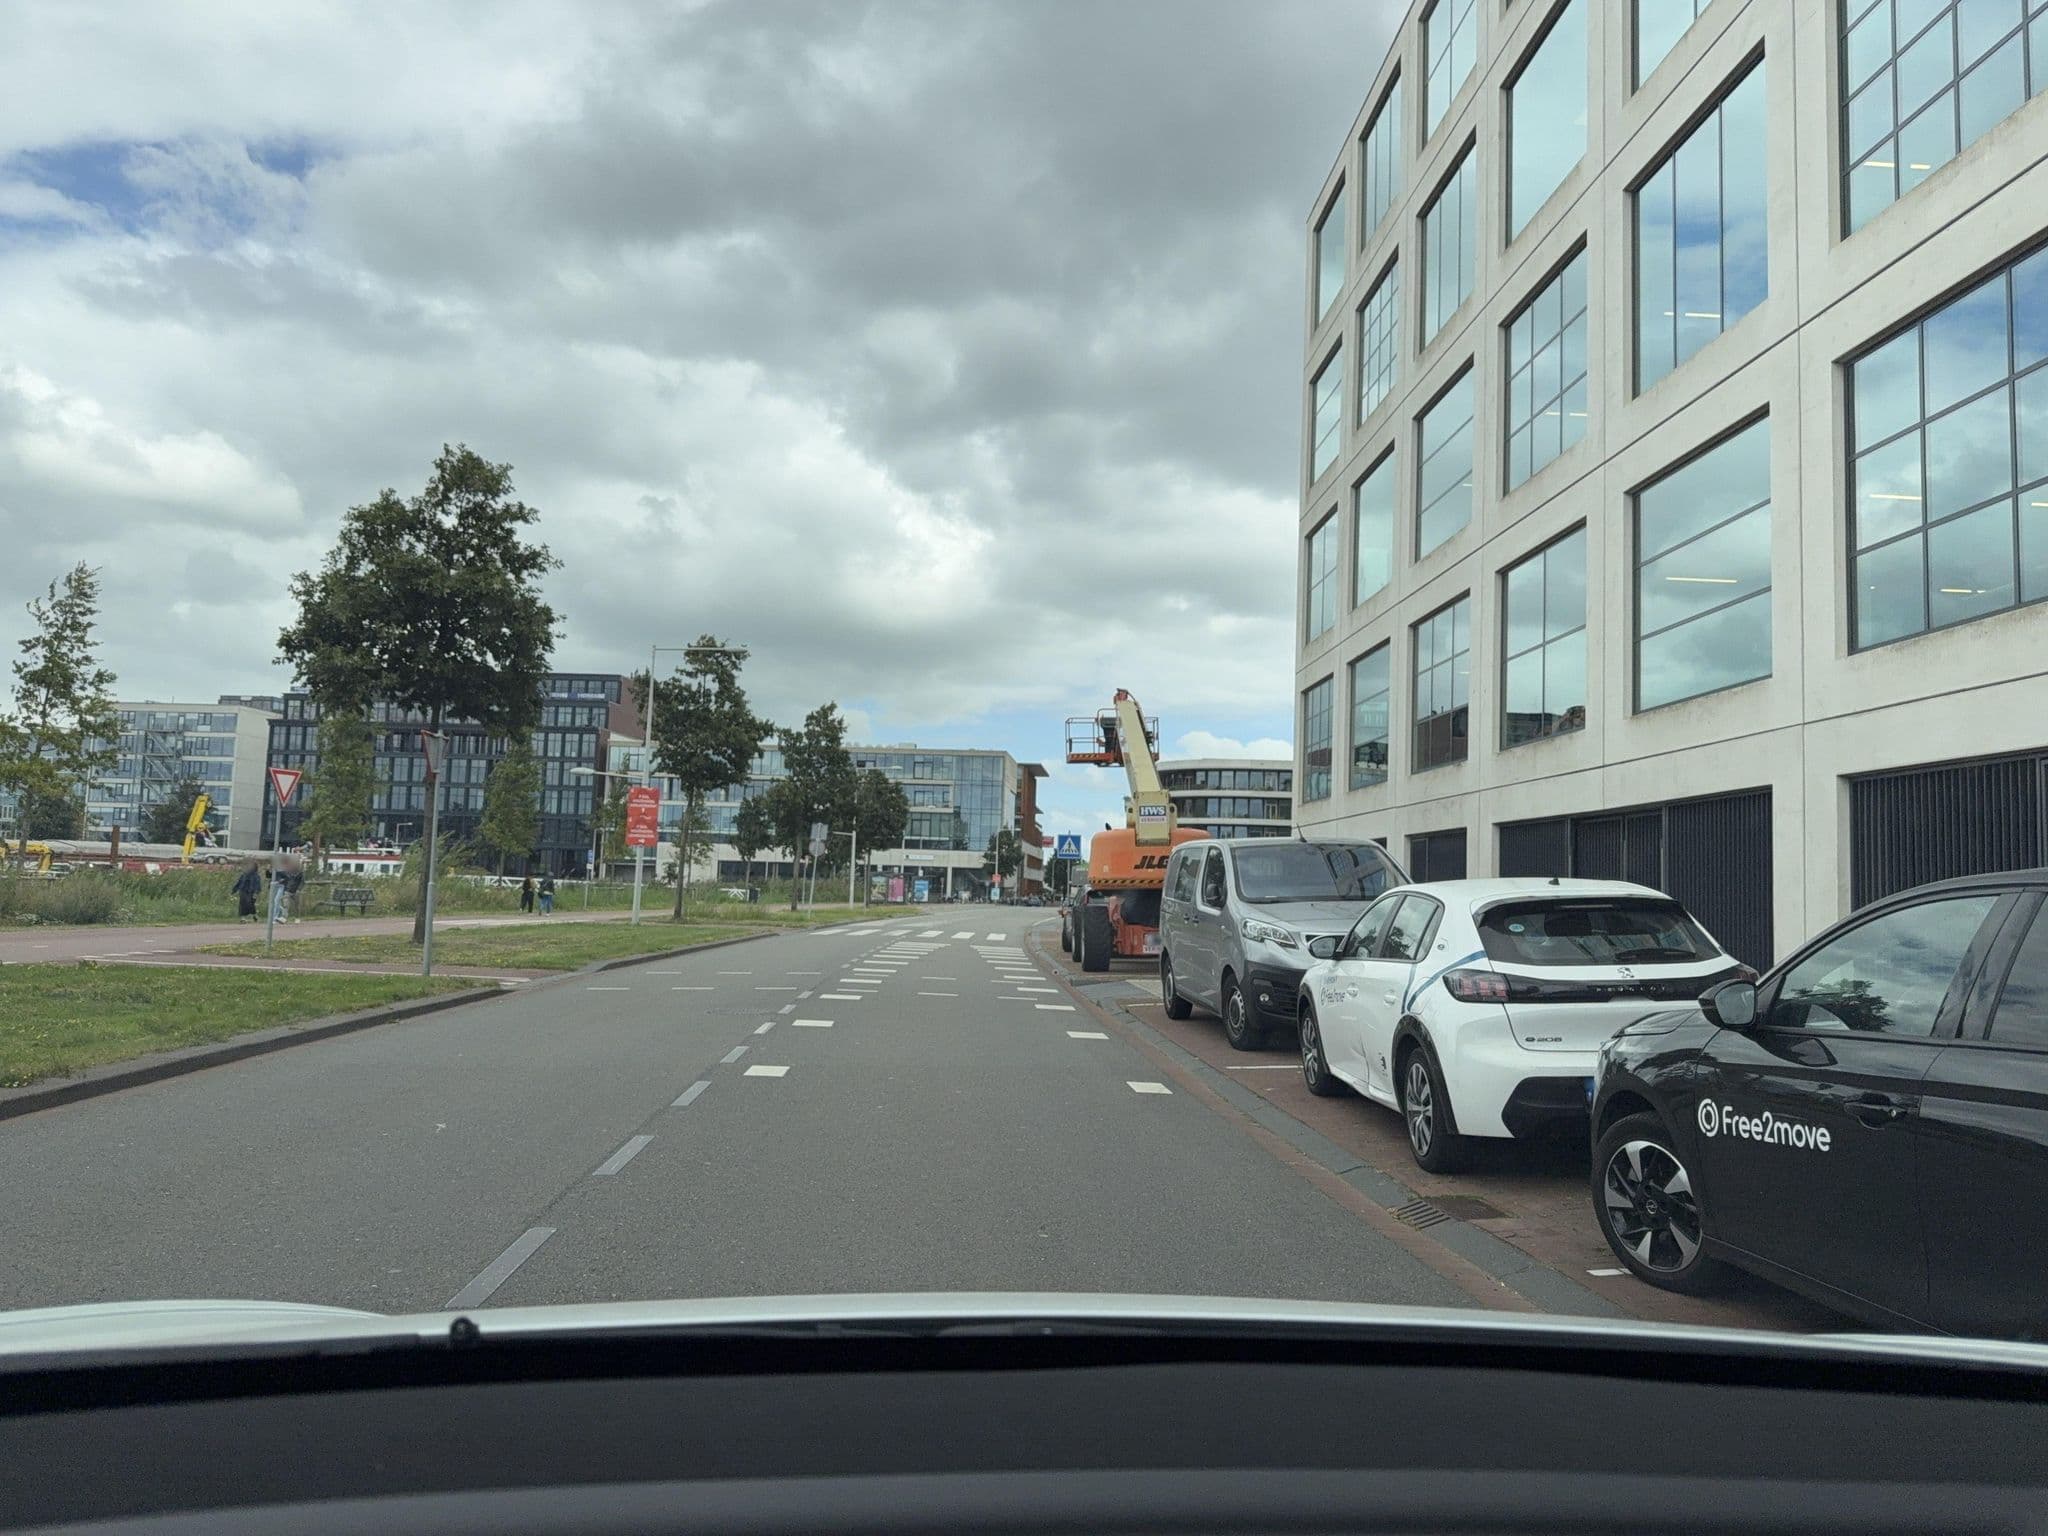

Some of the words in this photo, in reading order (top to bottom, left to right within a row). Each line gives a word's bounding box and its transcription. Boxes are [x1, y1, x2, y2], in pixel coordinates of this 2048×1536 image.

[1140, 806, 1165, 816] HWS
[1133, 855, 1169, 869] JLG
[1722, 1105, 1831, 1152] Free2move
